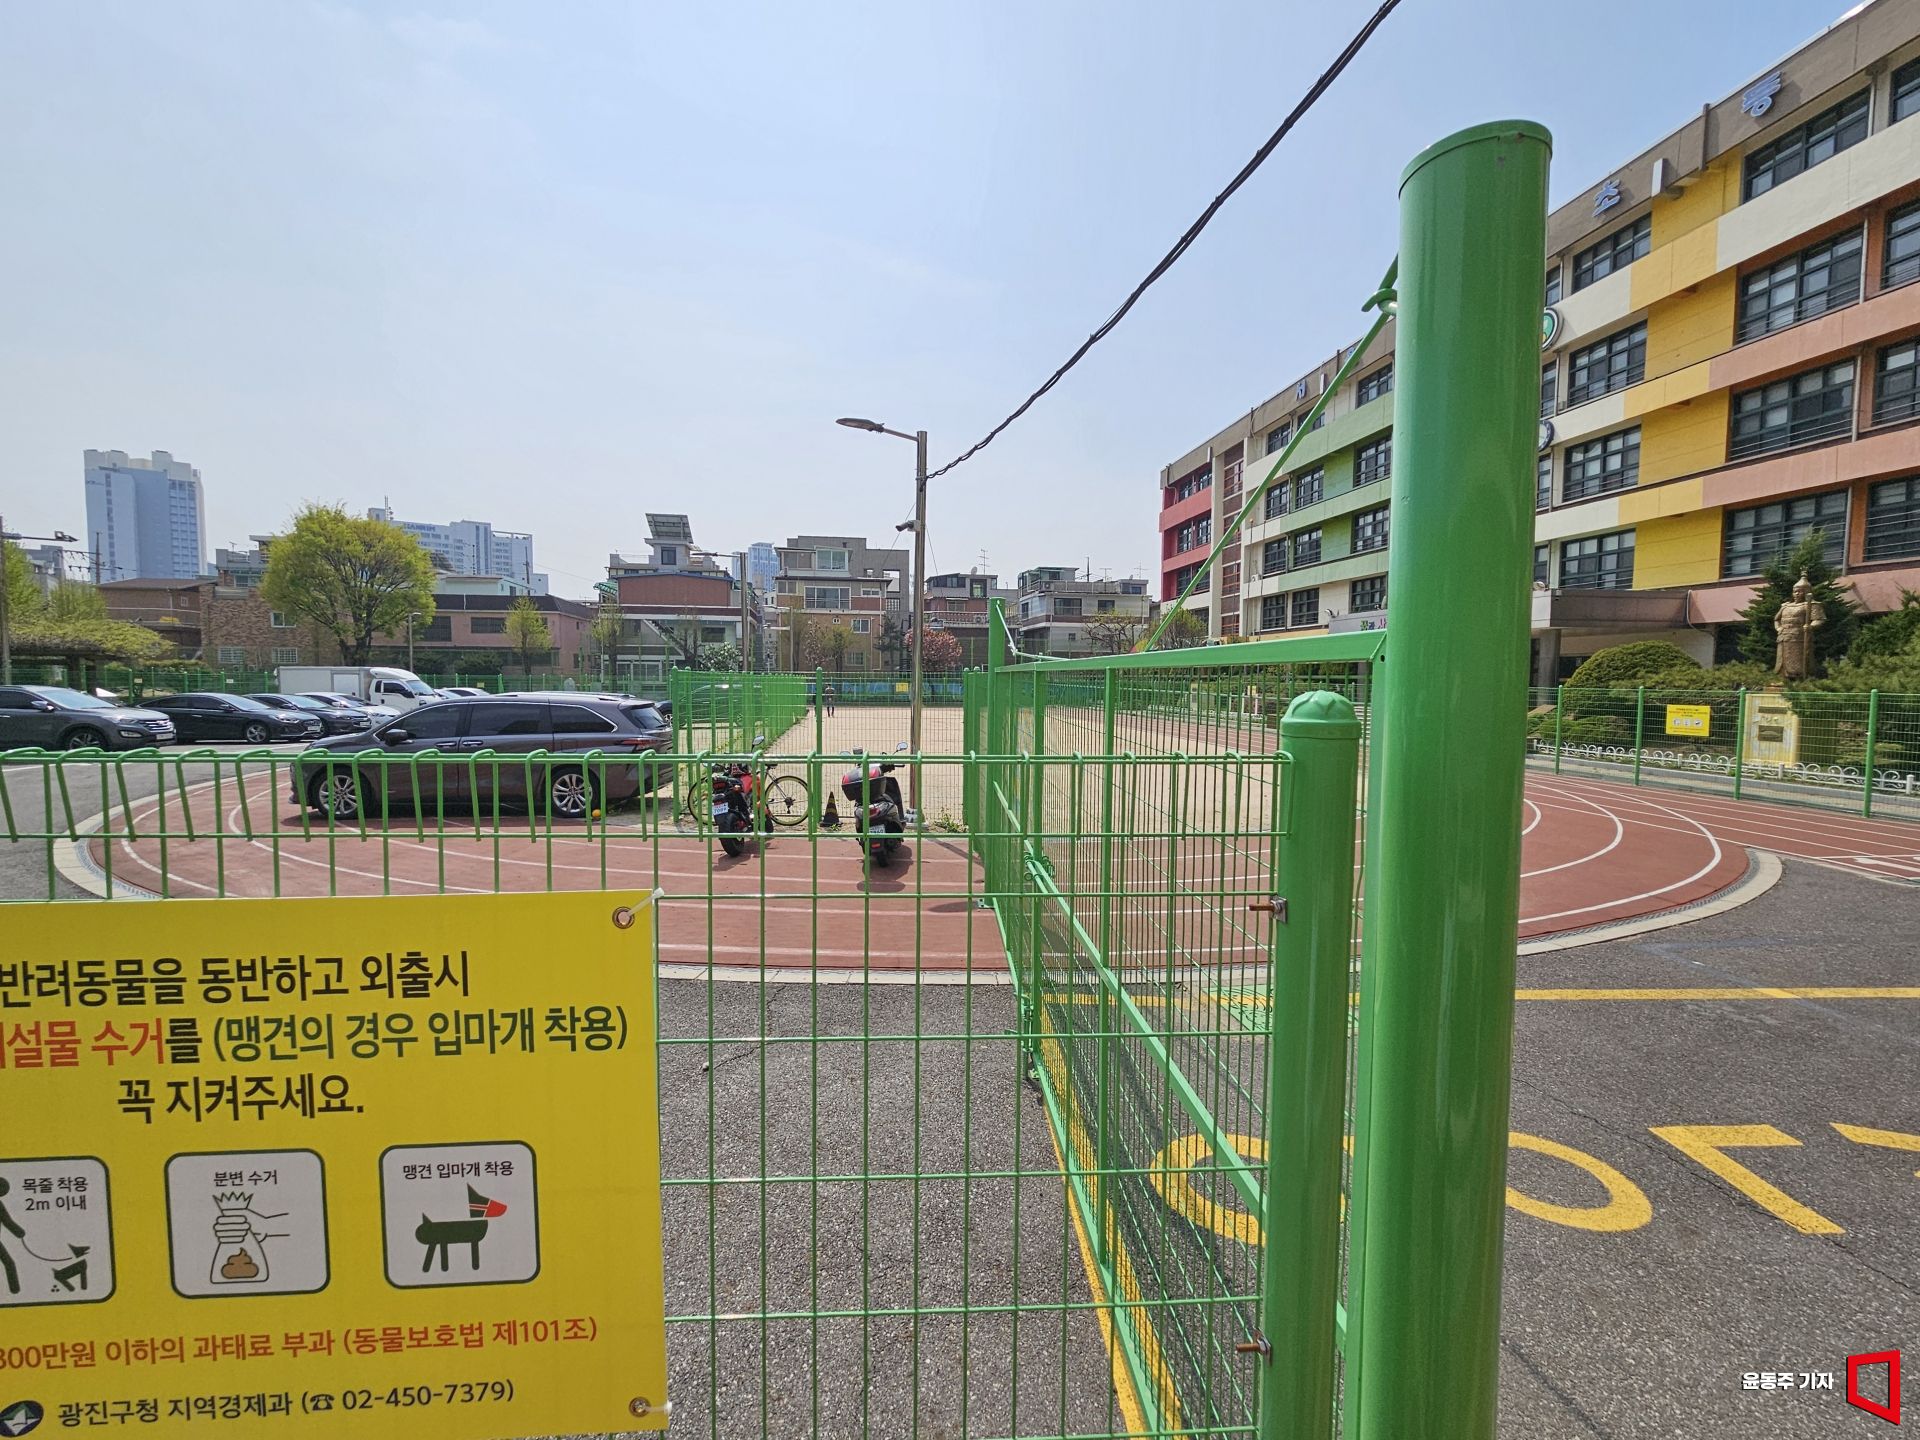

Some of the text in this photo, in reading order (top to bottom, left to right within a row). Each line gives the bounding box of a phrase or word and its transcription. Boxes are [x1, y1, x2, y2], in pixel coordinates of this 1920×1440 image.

[0, 951, 468, 1008] 반려동물을 동반하고 외출시
[92, 1018, 202, 1065] 수거를
[214, 1014, 334, 1062] (맹견의
[346, 1013, 418, 1058] 경우
[429, 1008, 534, 1056] 입마개
[545, 1006, 627, 1051] 착용)
[118, 1073, 363, 1124] 꼭 지켜주세요.
[22, 1177, 88, 1193] 목줄 착용
[214, 1170, 277, 1186] 분변 수거
[403, 1161, 513, 1179] 맹견 입마개 착용
[26, 1195, 86, 1210] 2m 이내
[106, 1337, 184, 1365] 이하의
[194, 1334, 274, 1361] 과태료
[282, 1330, 335, 1357] 부과
[344, 1322, 483, 1354] (동물보호법
[493, 1317, 596, 1345] 제101조)
[58, 1379, 513, 1427] 광진구청 지역경제과 02-450-7379)
